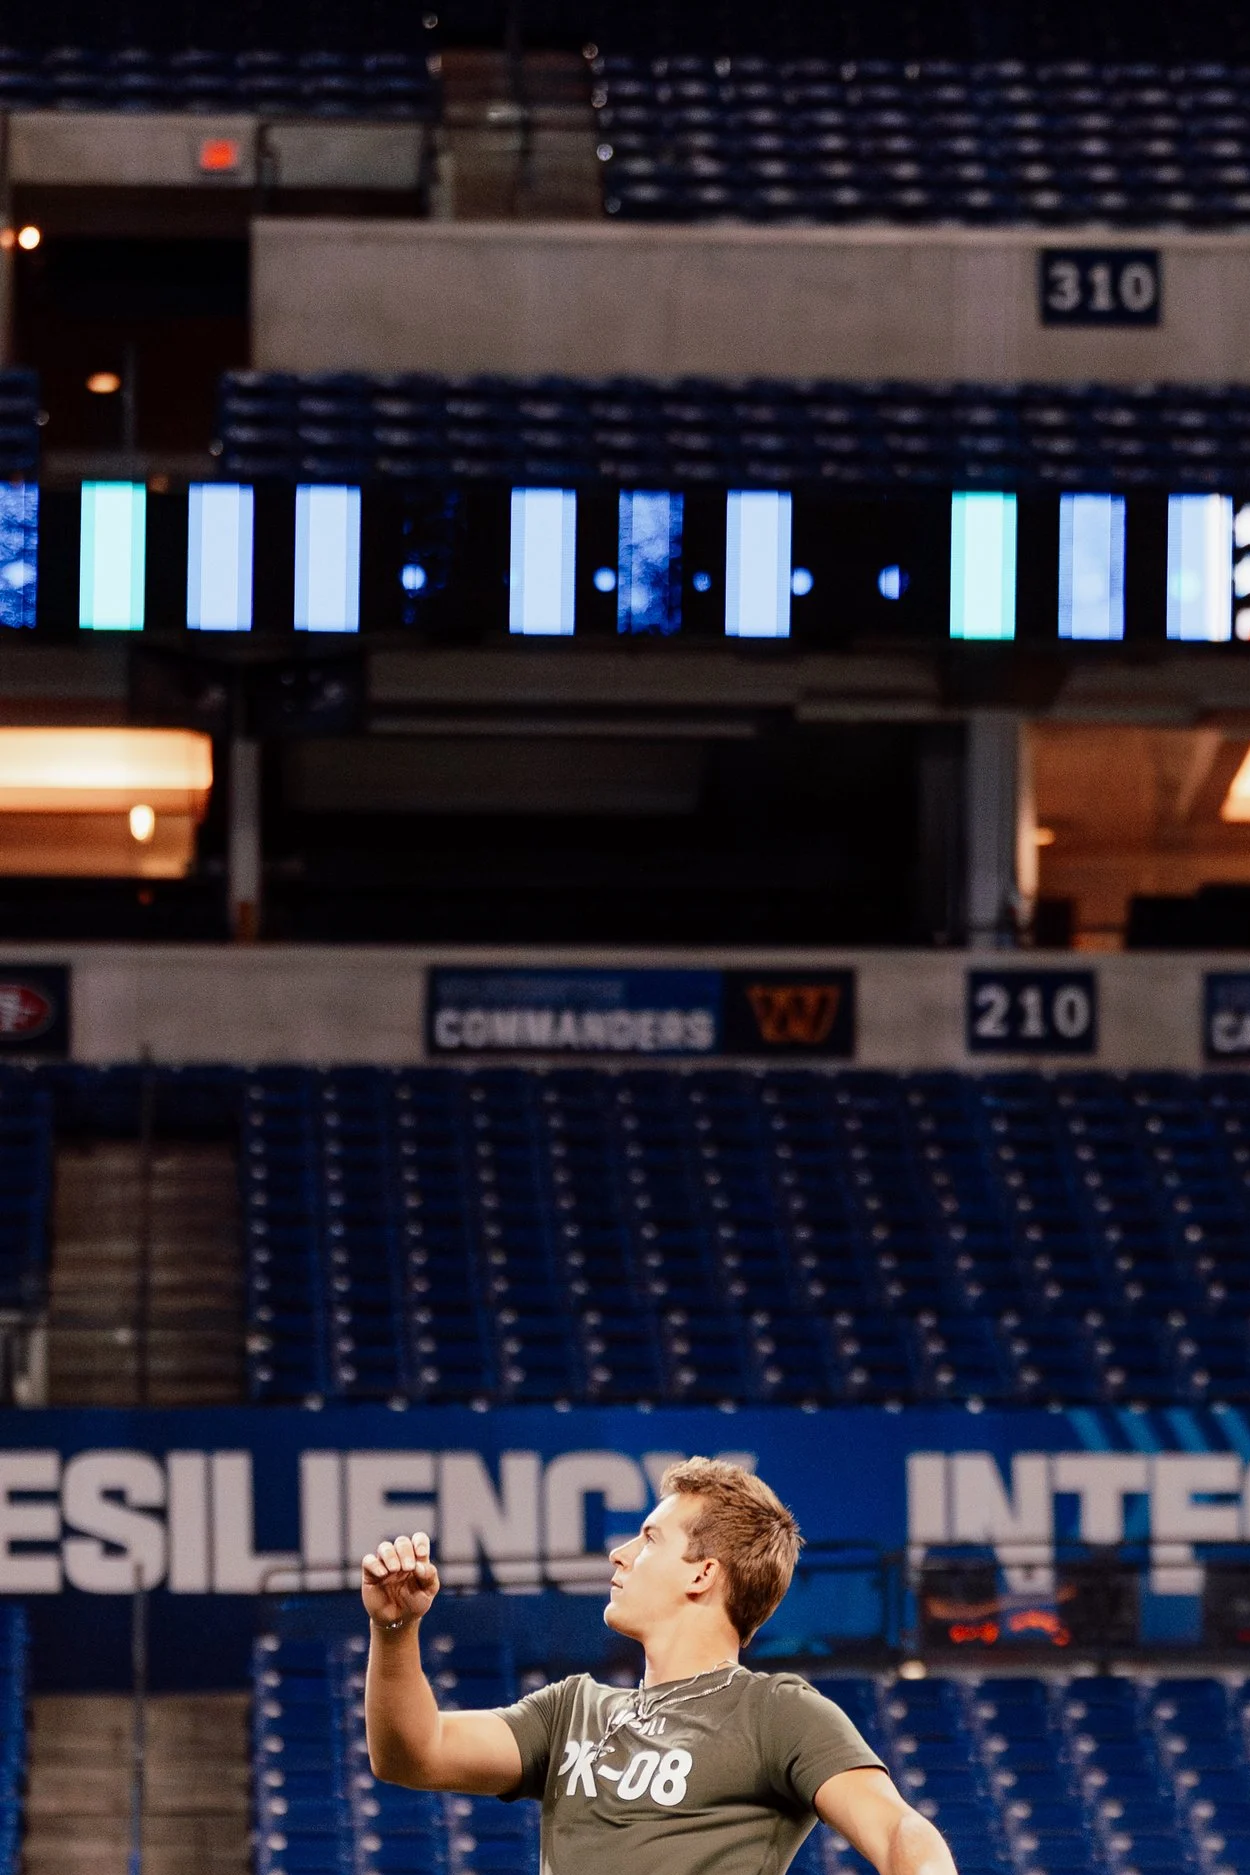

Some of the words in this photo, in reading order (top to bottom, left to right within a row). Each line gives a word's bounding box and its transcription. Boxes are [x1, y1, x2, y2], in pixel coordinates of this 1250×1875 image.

[1047, 260, 1155, 312] 310
[435, 1008, 716, 1050] COMMANDERS
[975, 985, 1090, 1038] 210
[0, 1449, 758, 1595] ESILIENC
